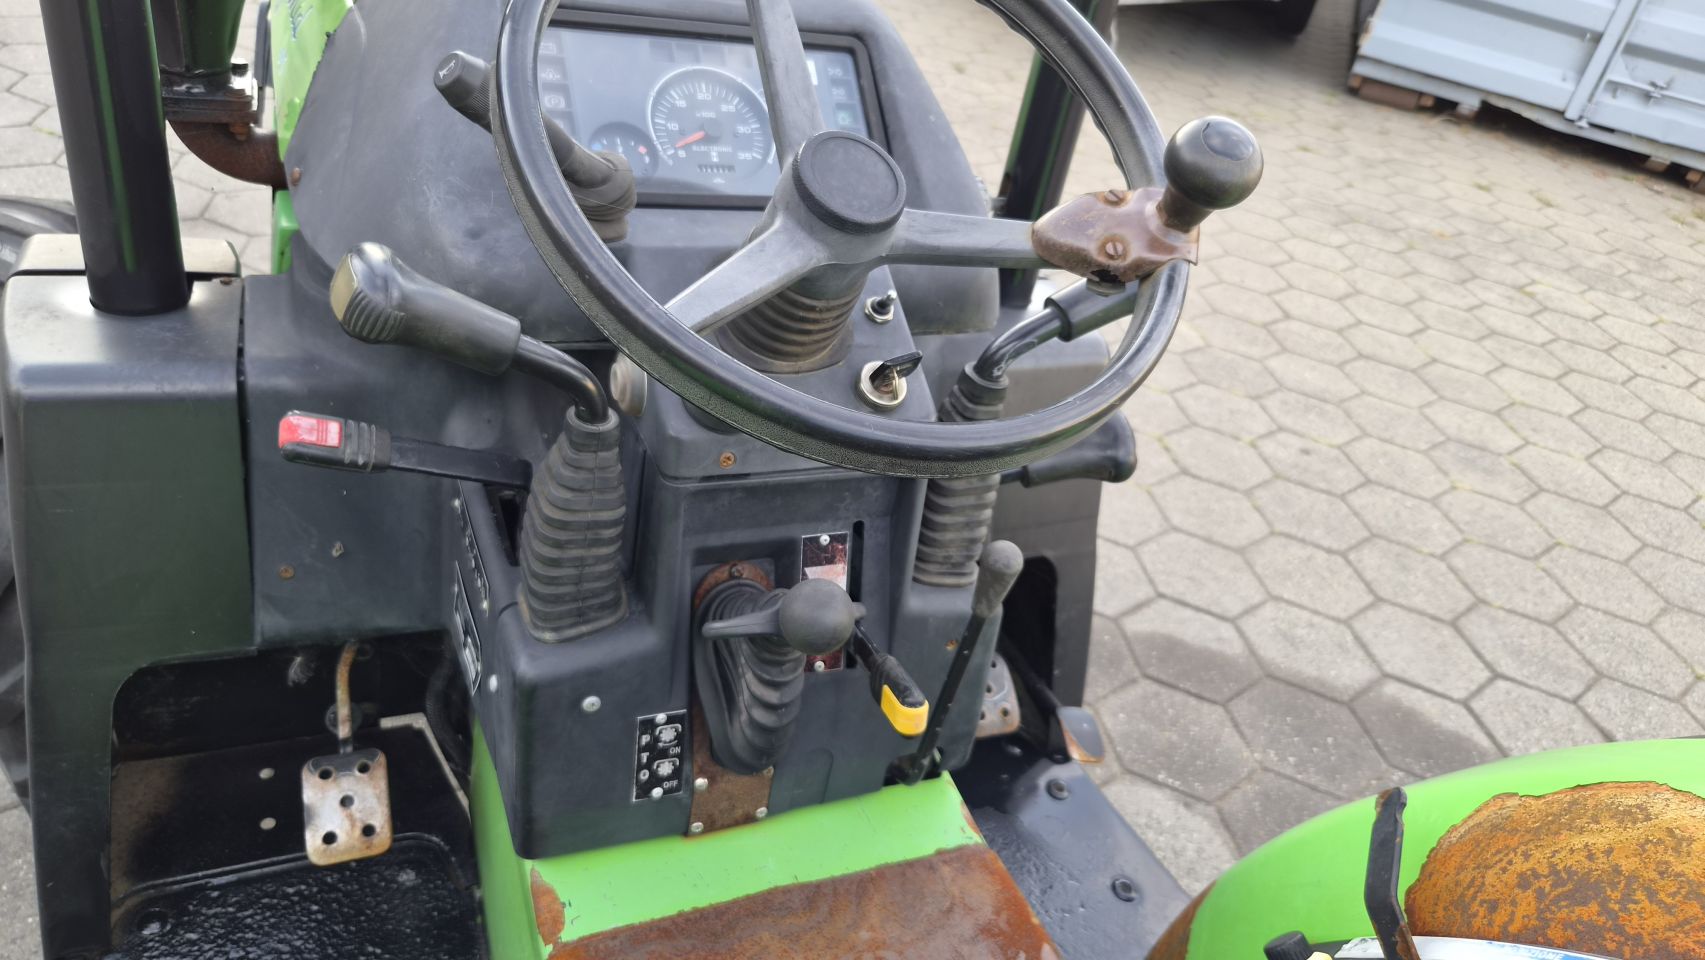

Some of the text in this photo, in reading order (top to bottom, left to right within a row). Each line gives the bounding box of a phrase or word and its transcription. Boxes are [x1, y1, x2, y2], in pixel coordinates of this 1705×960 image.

[666, 123, 679, 131] 10
[736, 126, 752, 134] 30
[670, 746, 681, 754] ON
[663, 780, 679, 789] OFF
